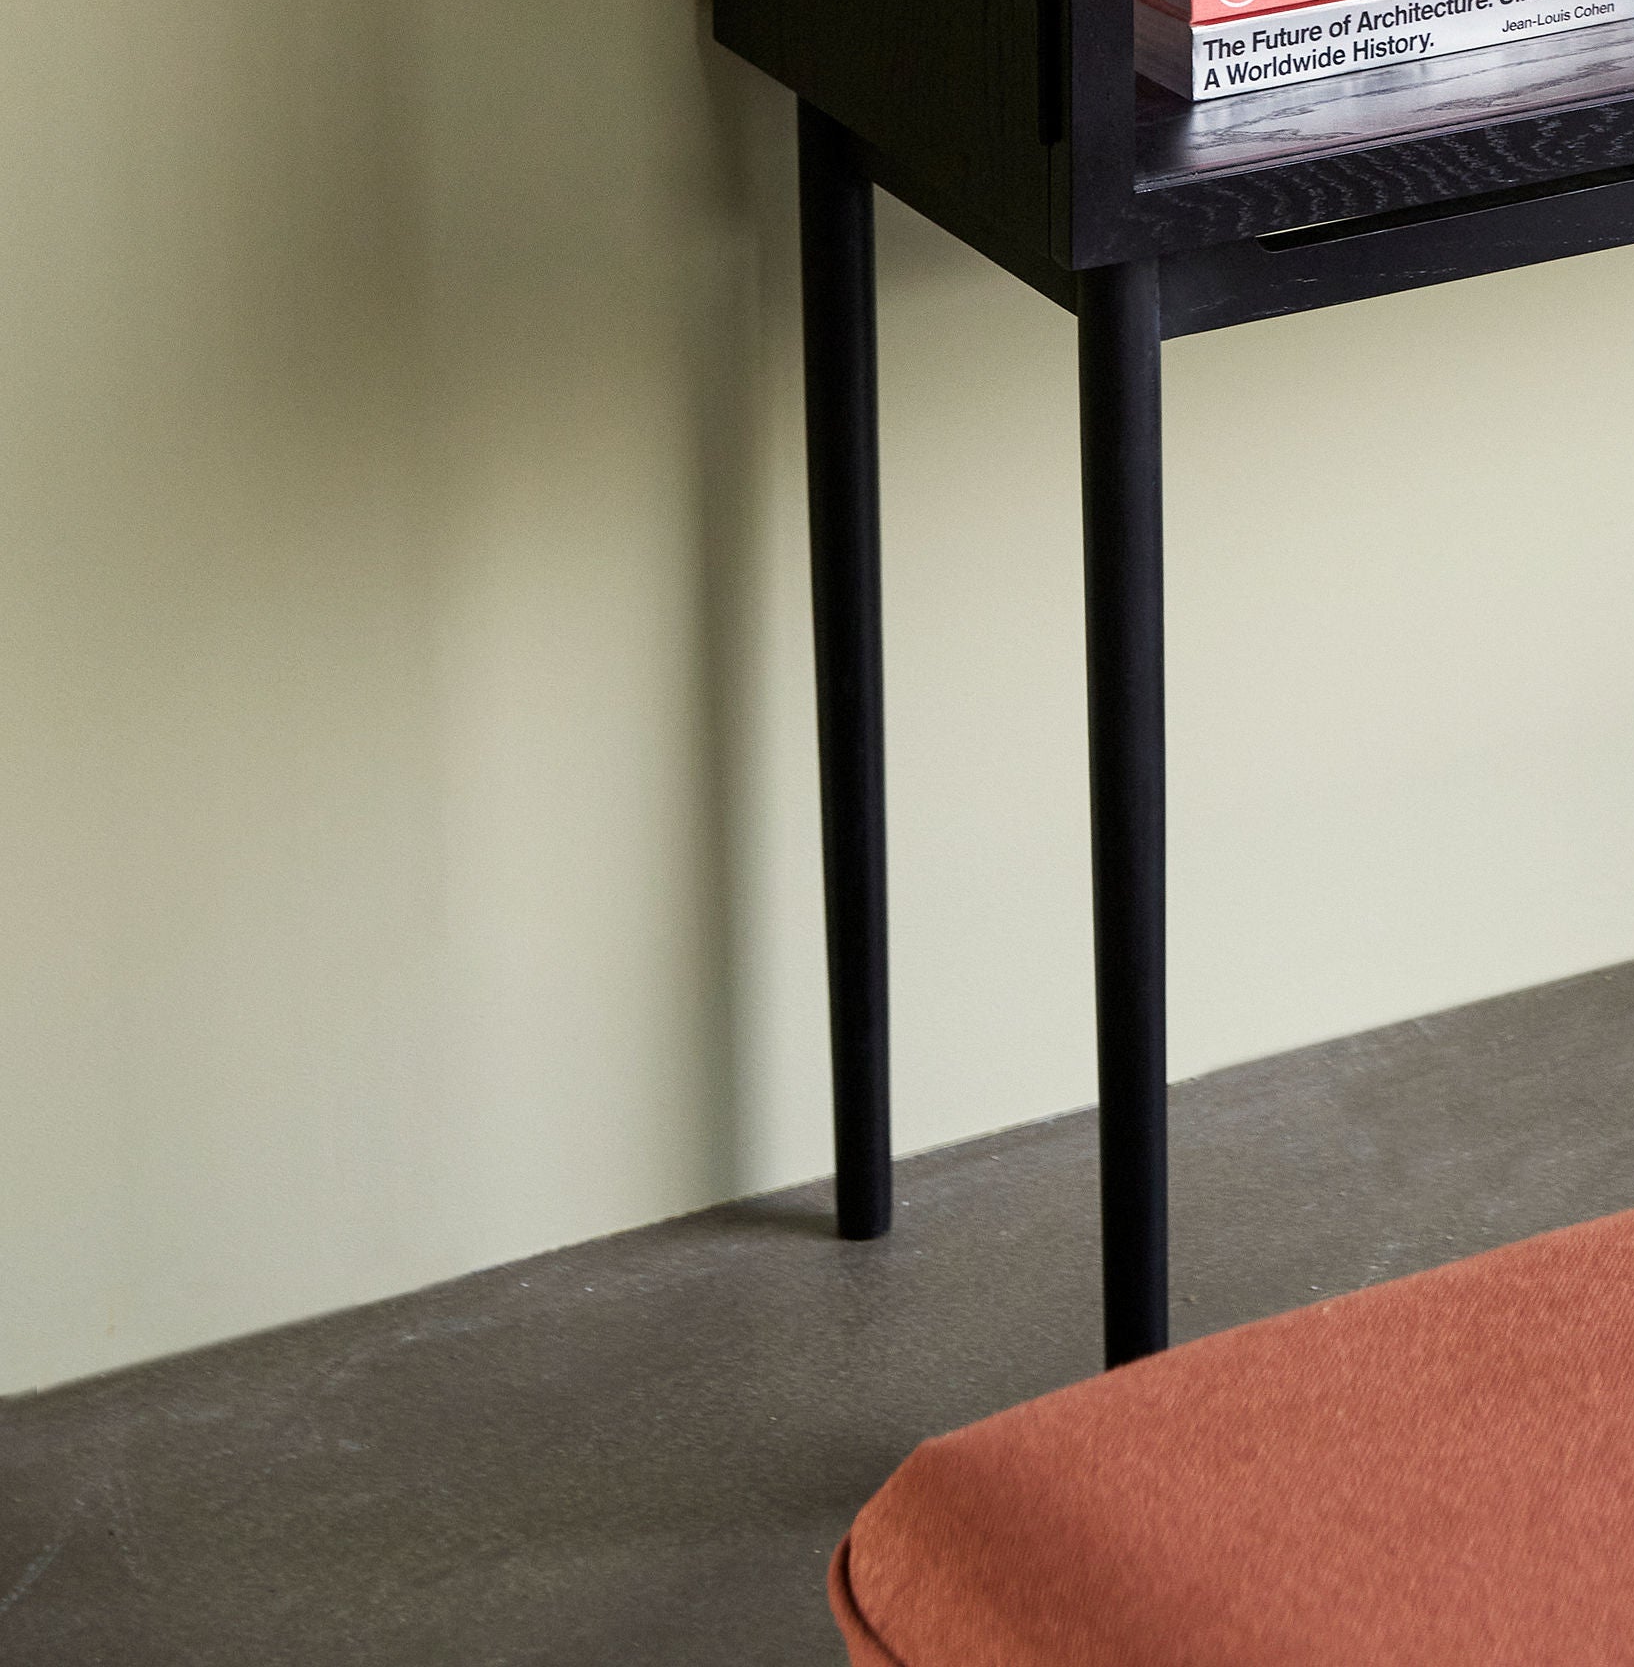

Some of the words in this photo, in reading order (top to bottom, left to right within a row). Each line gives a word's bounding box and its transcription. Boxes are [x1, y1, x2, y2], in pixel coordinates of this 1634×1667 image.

[1203, 38, 1246, 61] The
[1252, 24, 1322, 53] Future
[1329, 14, 1352, 37] of
[1502, 10, 1571, 33] Jean-Louis
[1573, 1, 1615, 19] Cohen
[1204, 68, 1220, 91] A
[1226, 46, 1346, 85] Worldwide
[1353, 32, 1435, 61] History.
